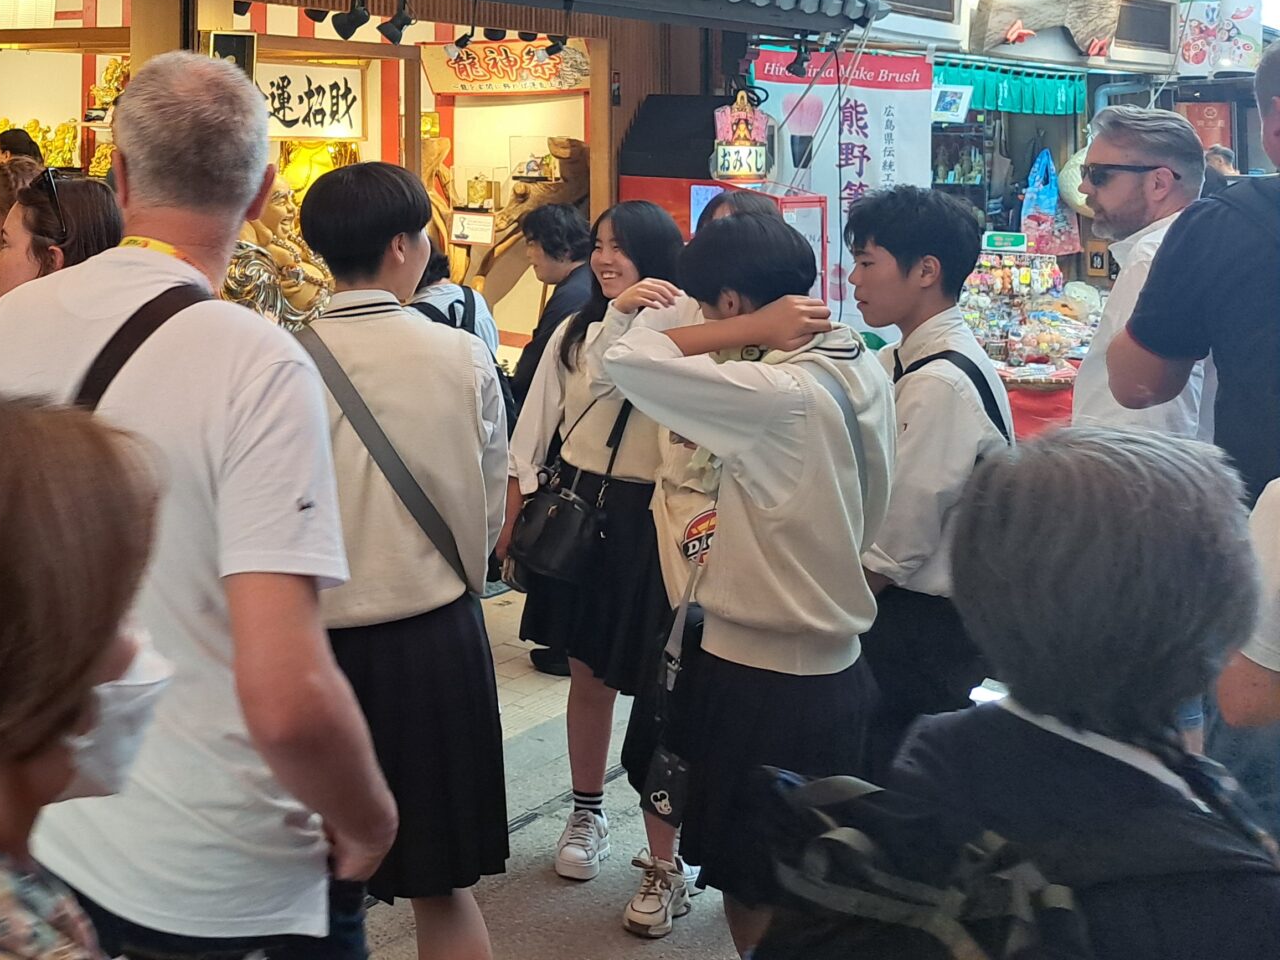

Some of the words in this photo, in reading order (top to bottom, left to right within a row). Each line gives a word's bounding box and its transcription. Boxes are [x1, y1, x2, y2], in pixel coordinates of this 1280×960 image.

[449, 46, 561, 82] 龍神祭
[878, 68, 920, 83] Brush
[256, 75, 357, 129] 運招財
[720, 148, 764, 172] おみくじ
